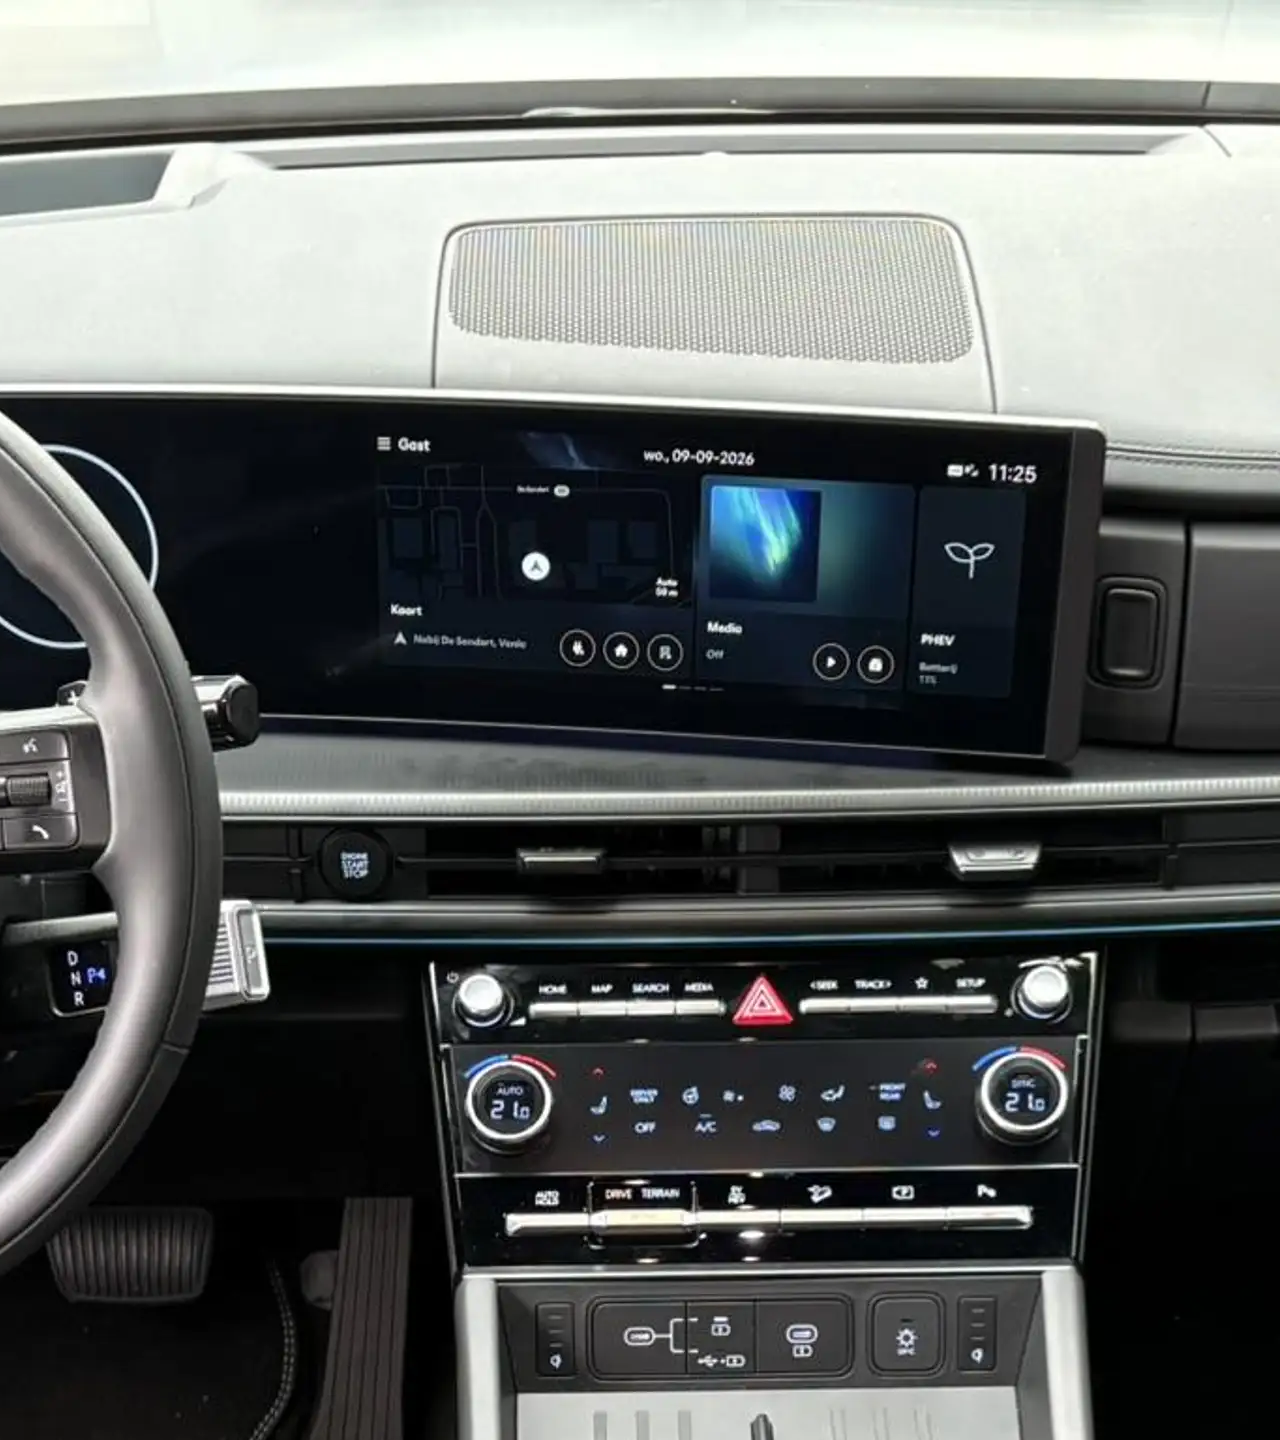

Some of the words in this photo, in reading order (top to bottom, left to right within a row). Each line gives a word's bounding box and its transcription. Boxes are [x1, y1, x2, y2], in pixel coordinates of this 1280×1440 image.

[397, 436, 432, 453] Gast
[671, 447, 755, 466] 09-09-2026
[987, 463, 1038, 483] 11:25
[390, 603, 423, 617] Kaart
[706, 621, 743, 635] Media
[920, 633, 957, 647] PHEV
[66, 950, 79, 968] D
[70, 970, 82, 987] N
[955, 977, 986, 989] SETUP
[538, 983, 568, 995] HOME
[590, 983, 613, 994] MAP
[631, 982, 670, 994] SEARCH
[683, 981, 714, 993] MEDIA
[73, 991, 86, 1007] R
[634, 1121, 656, 1134] OFF
[604, 1188, 632, 1200] DRIVE
[640, 1187, 681, 1199] TERRAIN
